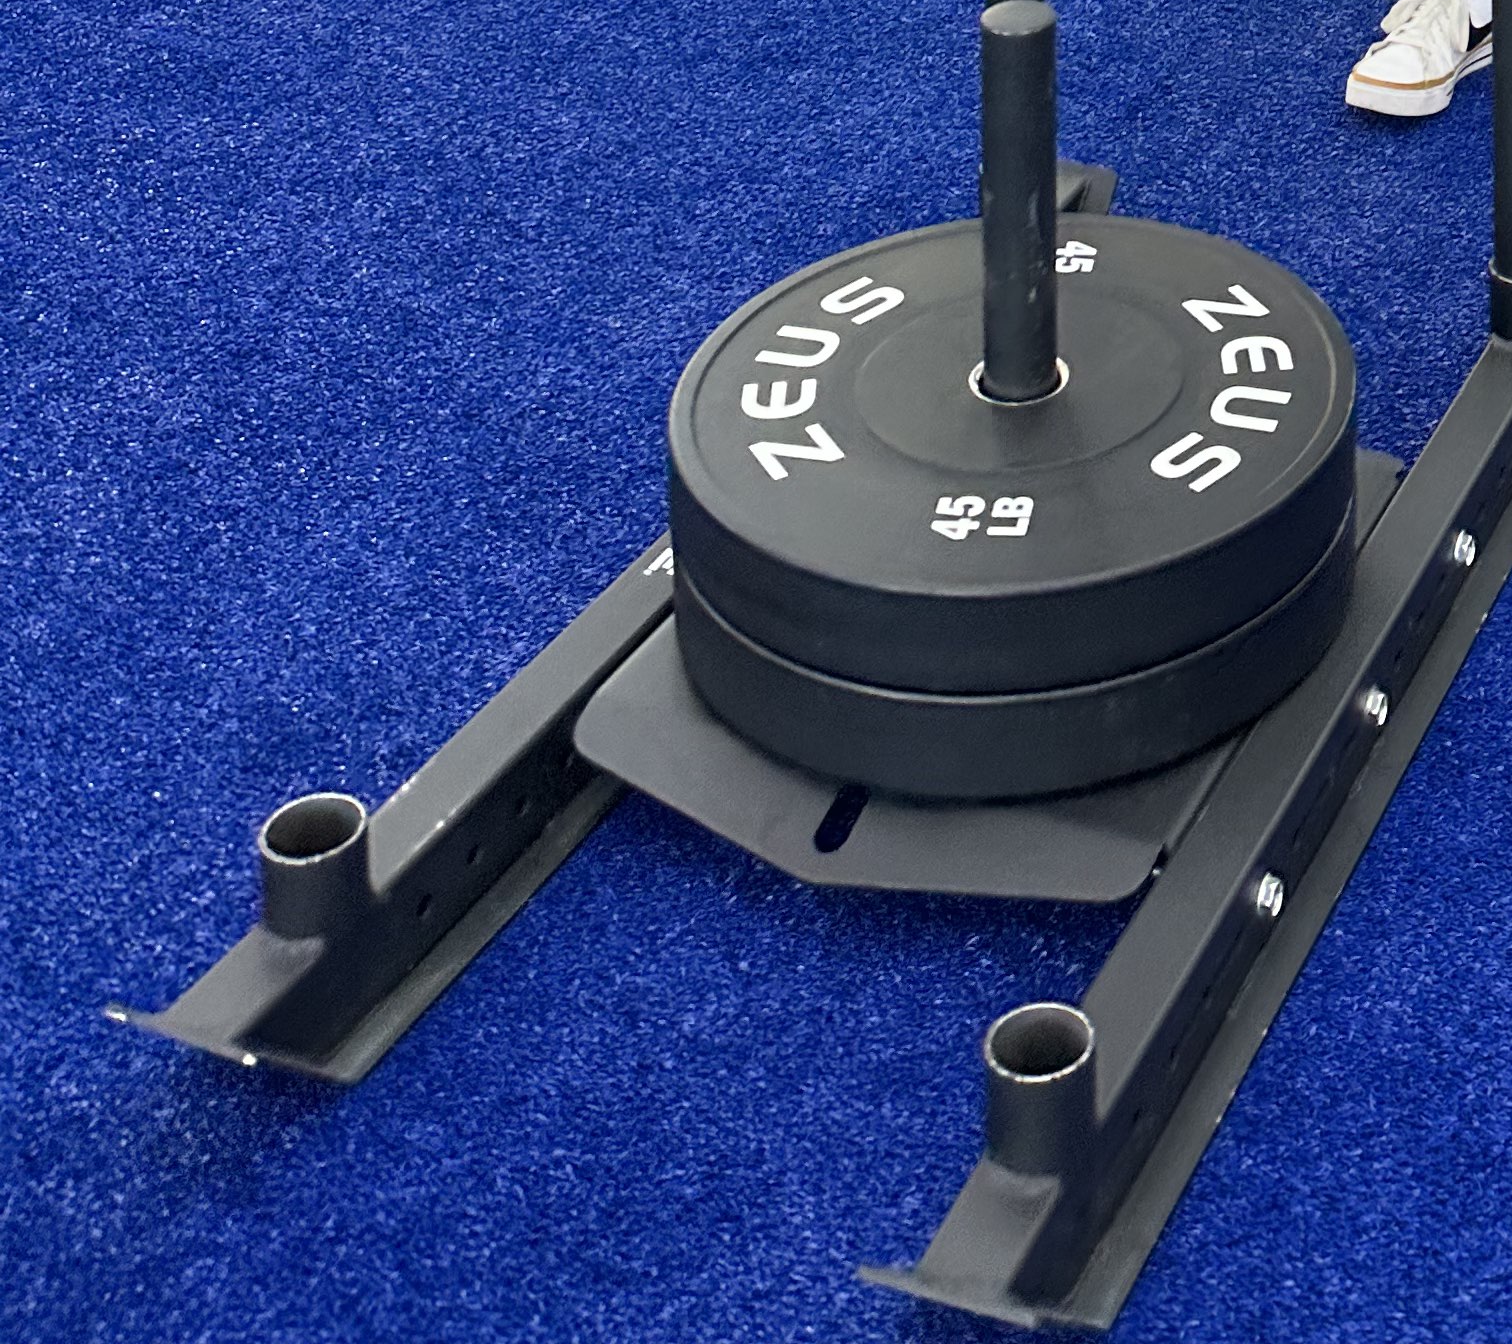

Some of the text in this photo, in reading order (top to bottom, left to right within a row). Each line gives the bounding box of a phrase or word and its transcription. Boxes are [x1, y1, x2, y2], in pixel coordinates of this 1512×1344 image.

[1054, 240, 1098, 273] 45
[741, 276, 905, 481] ZEUS
[1150, 284, 1294, 492] ZEUS
[931, 495, 985, 541] 45
[986, 496, 1034, 536] LB
